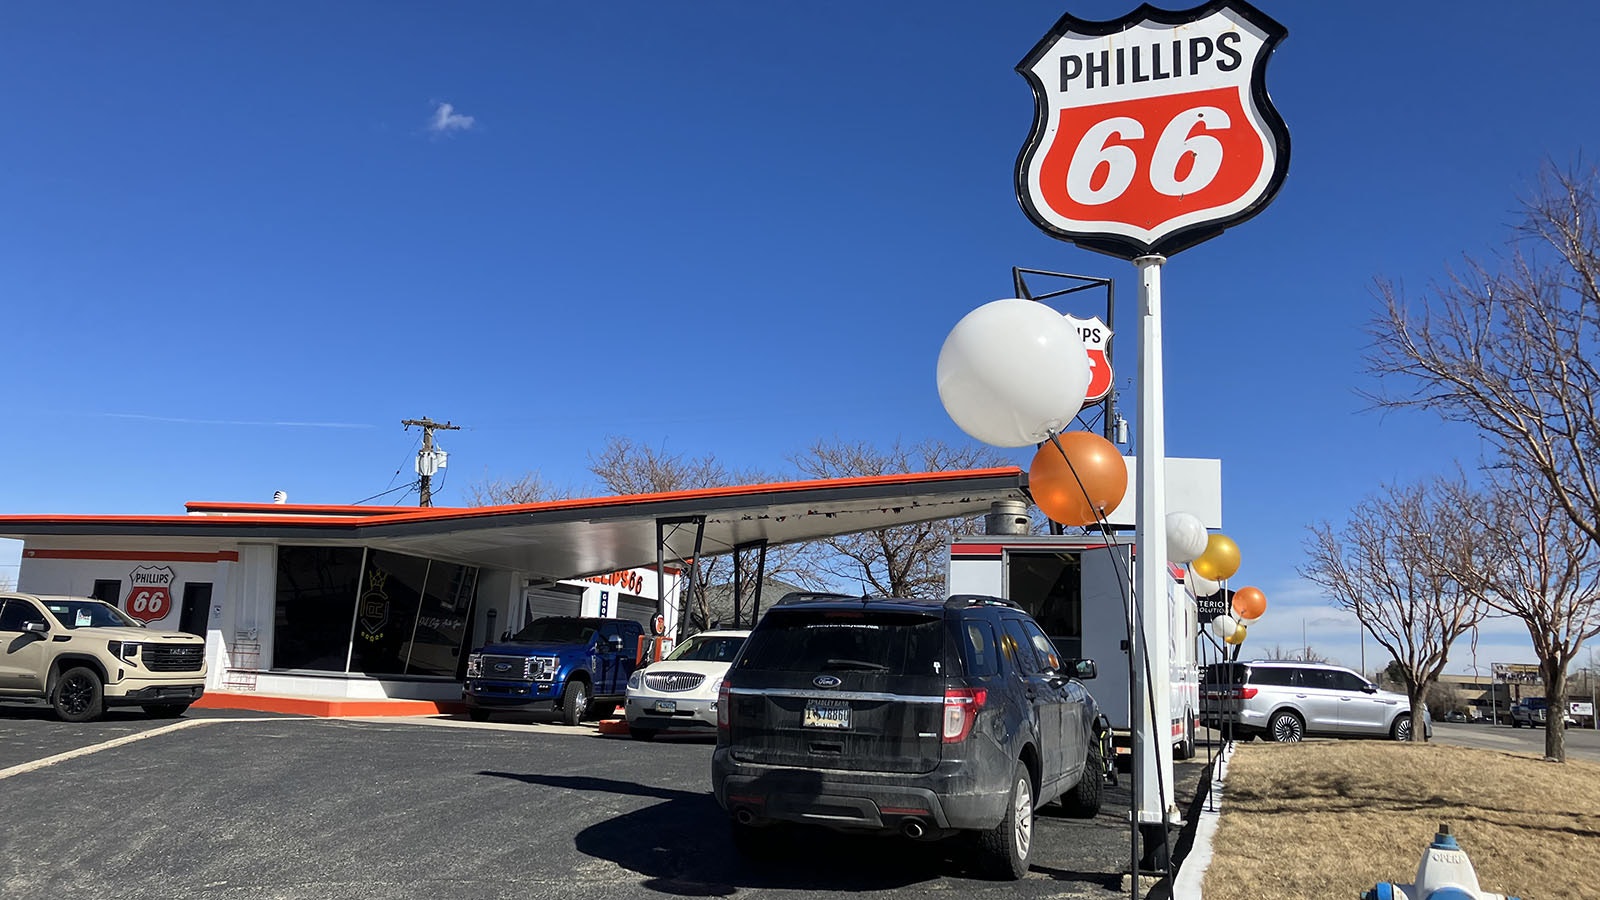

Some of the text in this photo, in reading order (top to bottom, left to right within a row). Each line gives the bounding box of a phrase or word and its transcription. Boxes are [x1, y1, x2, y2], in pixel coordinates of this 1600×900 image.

[1059, 31, 1242, 93] PHILLIPS
[1066, 106, 1231, 206] 66
[135, 573, 169, 584] PHILLIPS
[133, 591, 165, 613] 66
